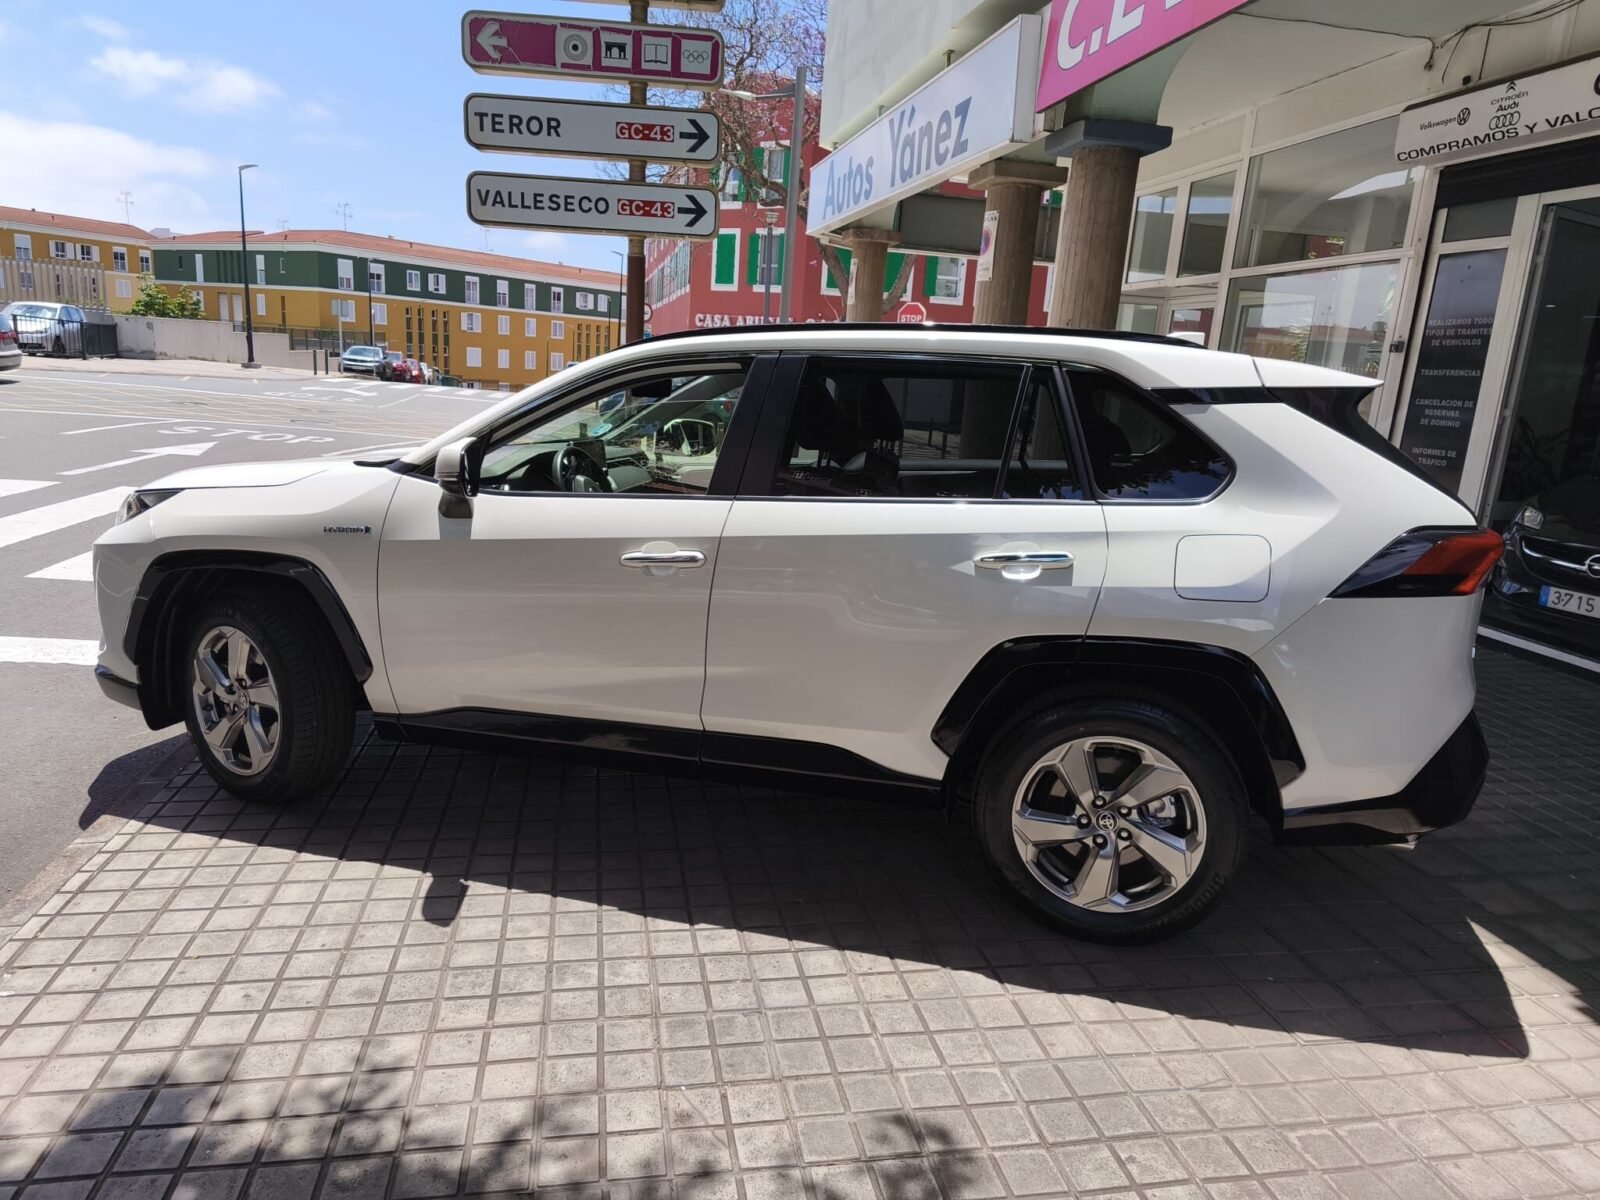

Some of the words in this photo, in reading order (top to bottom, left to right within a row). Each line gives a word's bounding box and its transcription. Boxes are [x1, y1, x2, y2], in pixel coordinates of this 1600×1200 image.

[474, 111, 561, 138] TEROR
[616, 123, 674, 142] GC-43
[1419, 116, 1457, 131] Volkswagen
[1397, 126, 1519, 162] COMPRAMOS
[1524, 122, 1538, 134] Y
[823, 155, 874, 221] Autos
[888, 96, 973, 188] Yánez
[476, 188, 610, 215] VALLESECO
[617, 199, 675, 219] GC-43
[695, 313, 731, 328] CASA
[901, 314, 922, 323] STOP
[1428, 317, 1472, 326] REALIZAMOS
[1425, 328, 1445, 337] TIPOS
[1446, 328, 1455, 336] DE
[1431, 338, 1441, 346] DE
[1420, 368, 1481, 377] TRANSFERENCIAS
[1463, 400, 1474, 408] DE
[1430, 418, 1461, 428] DOMINIO
[157, 425, 336, 445] STOP
[1412, 447, 1446, 456] INFORMES
[1551, 591, 1596, 613] 3715
